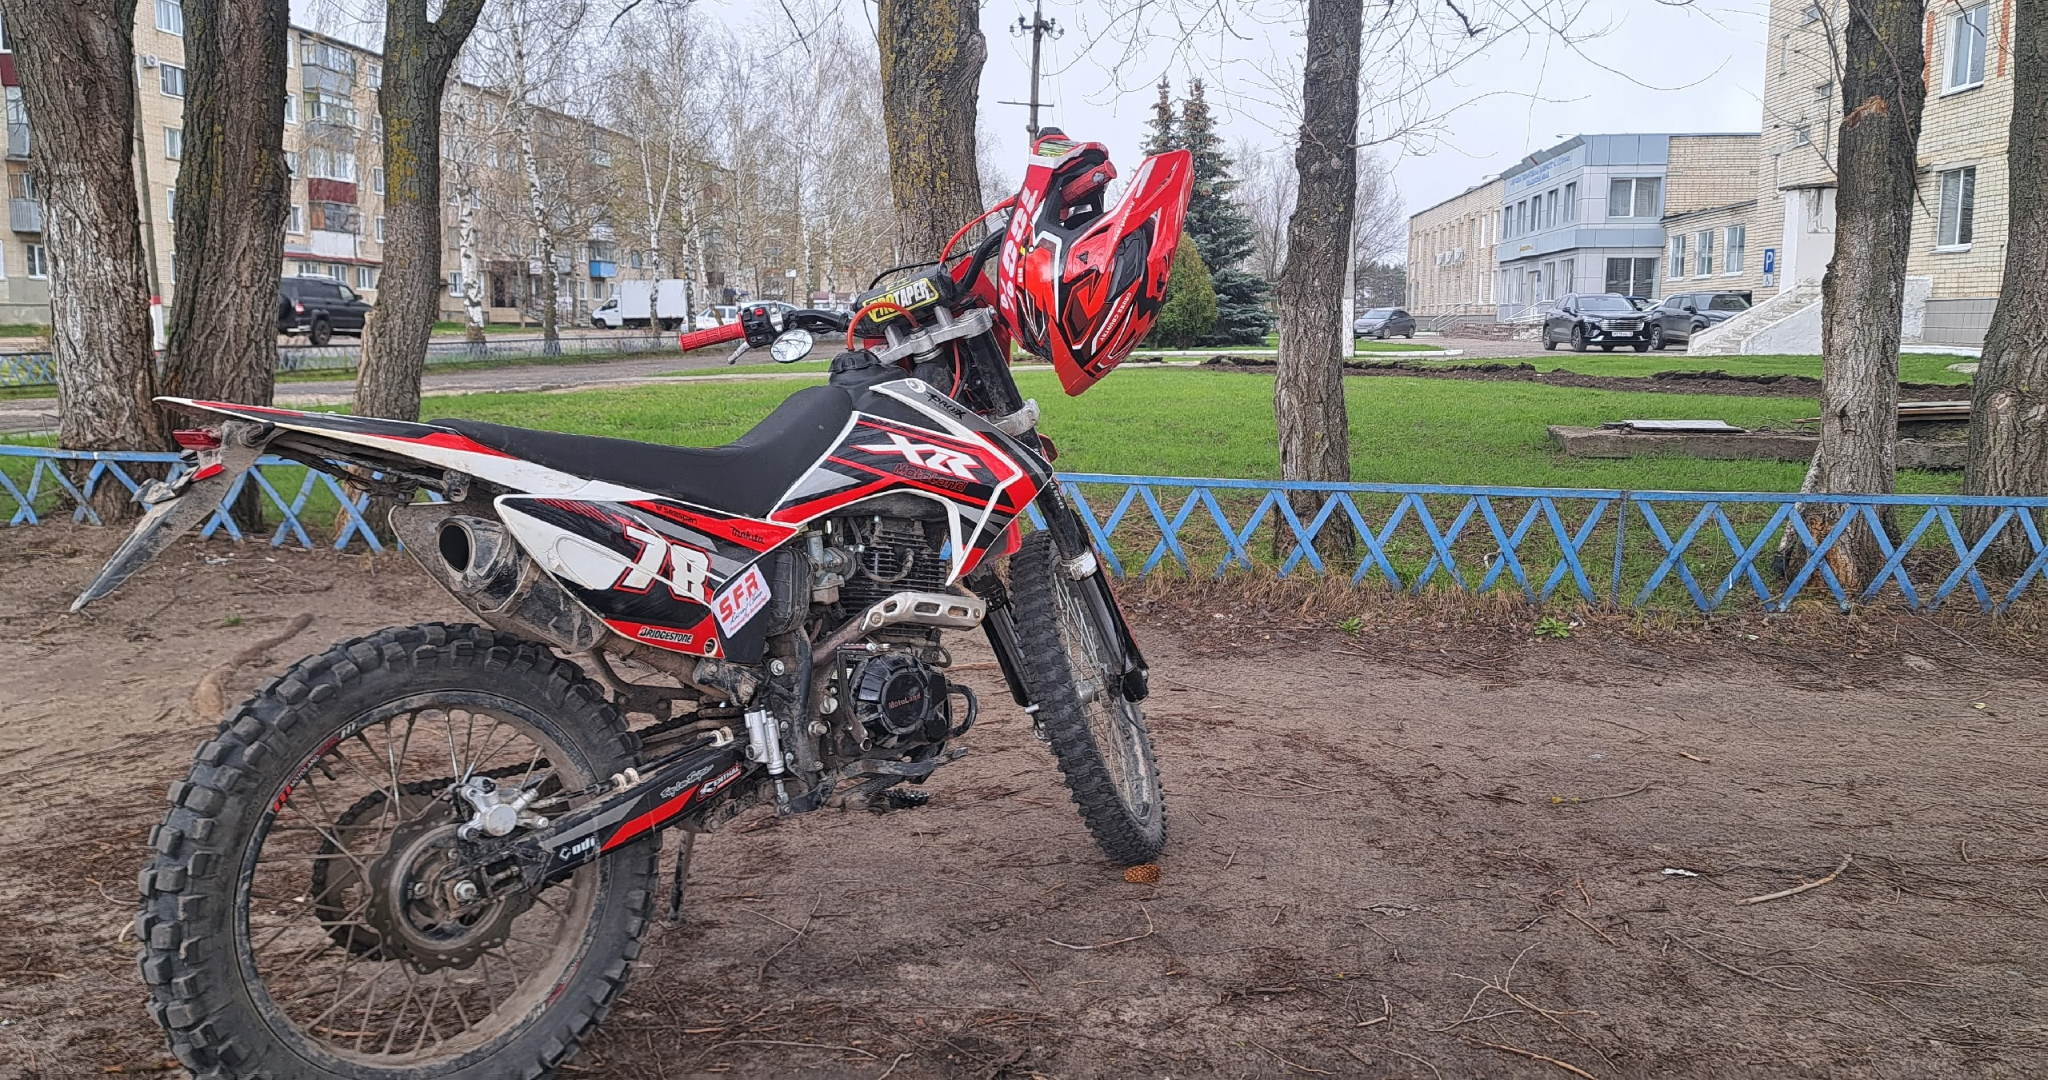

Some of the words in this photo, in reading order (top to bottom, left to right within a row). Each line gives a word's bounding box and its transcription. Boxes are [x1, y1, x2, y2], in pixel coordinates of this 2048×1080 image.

[1765, 251, 1774, 271] P
[849, 432, 982, 483] XR
[617, 525, 711, 602] 78
[638, 627, 694, 645] BRIDGESTONE
[888, 692, 922, 709] MotoLand
[572, 836, 596, 855] odi
